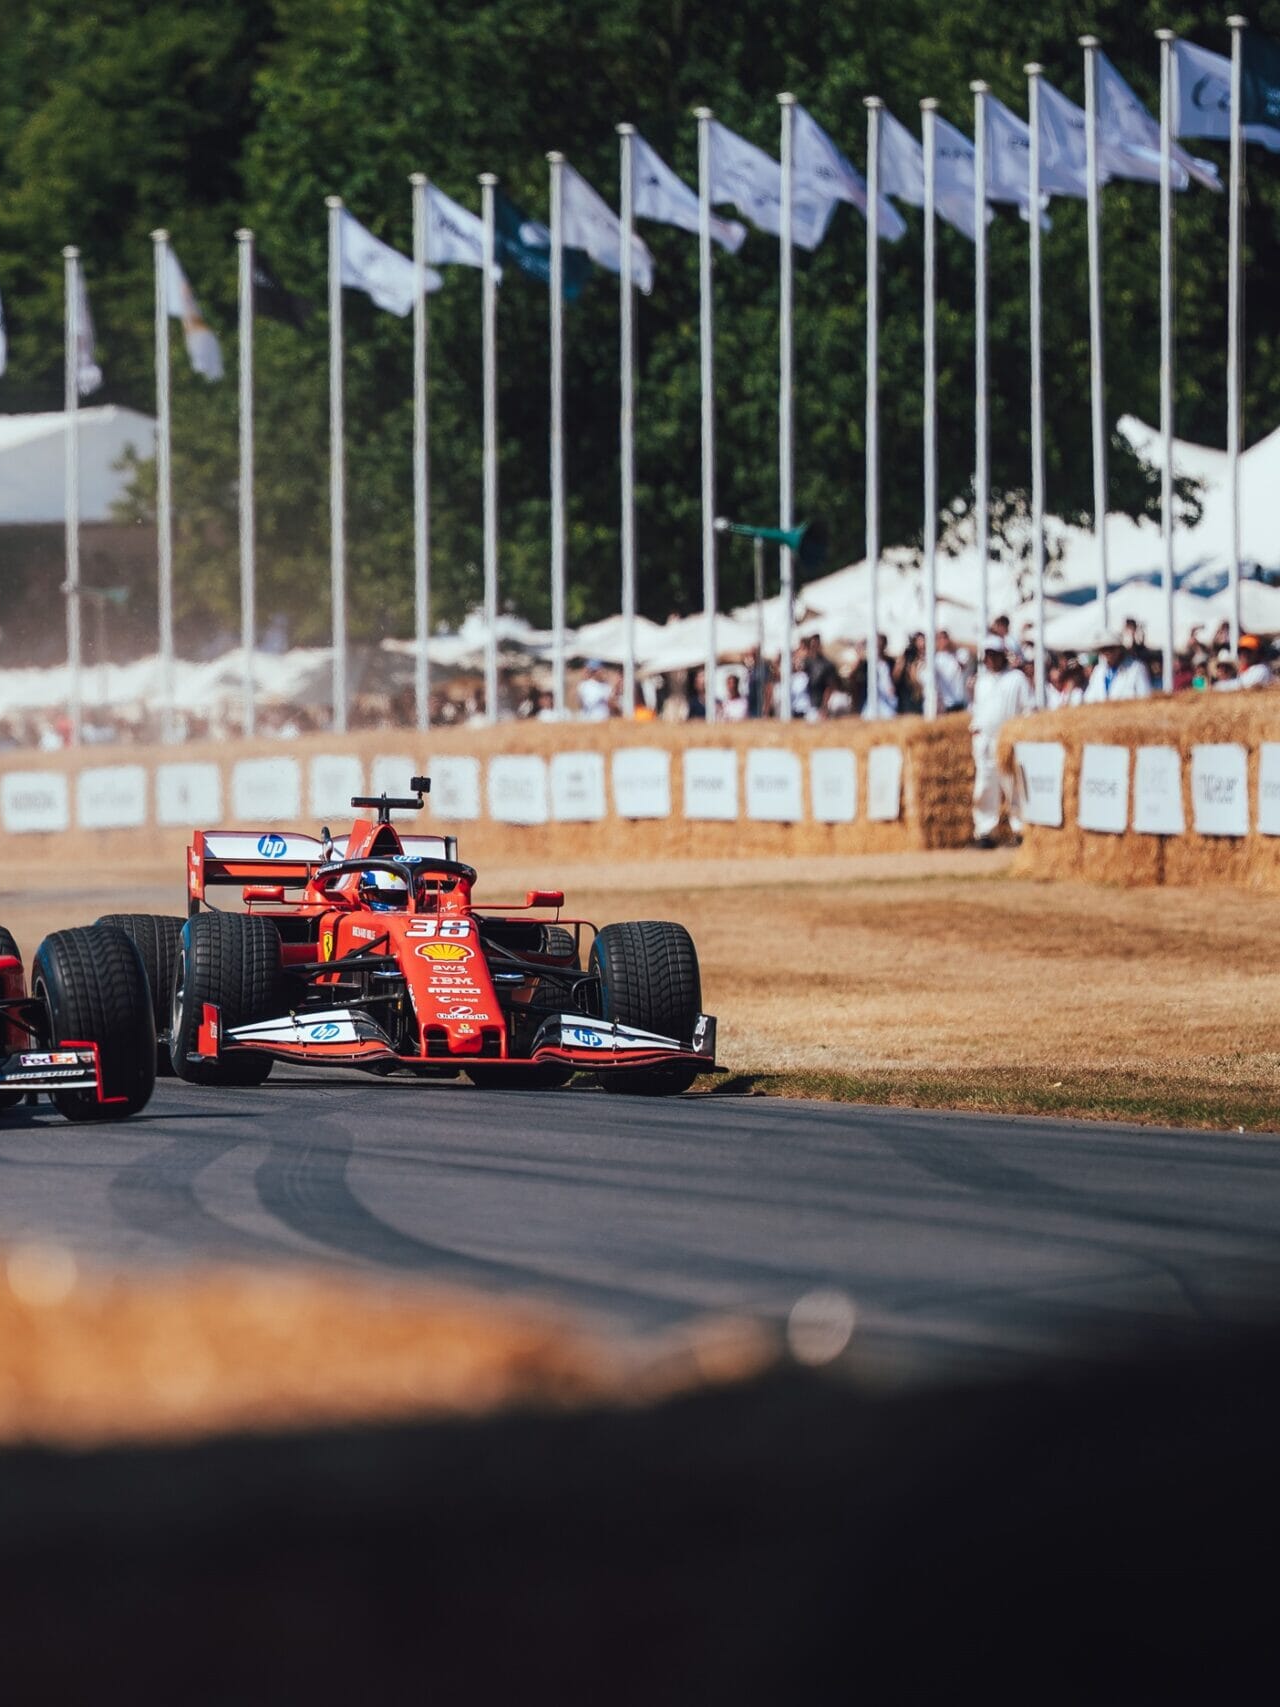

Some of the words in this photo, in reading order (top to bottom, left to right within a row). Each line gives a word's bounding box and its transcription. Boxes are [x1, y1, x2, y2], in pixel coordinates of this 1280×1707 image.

[260, 835, 285, 857] hp
[405, 919, 470, 938] 38
[432, 965, 467, 973] aws
[430, 977, 474, 985] IBM
[313, 1024, 338, 1039] hp
[577, 1028, 599, 1046] hp
[22, 1053, 74, 1065] FedEx
